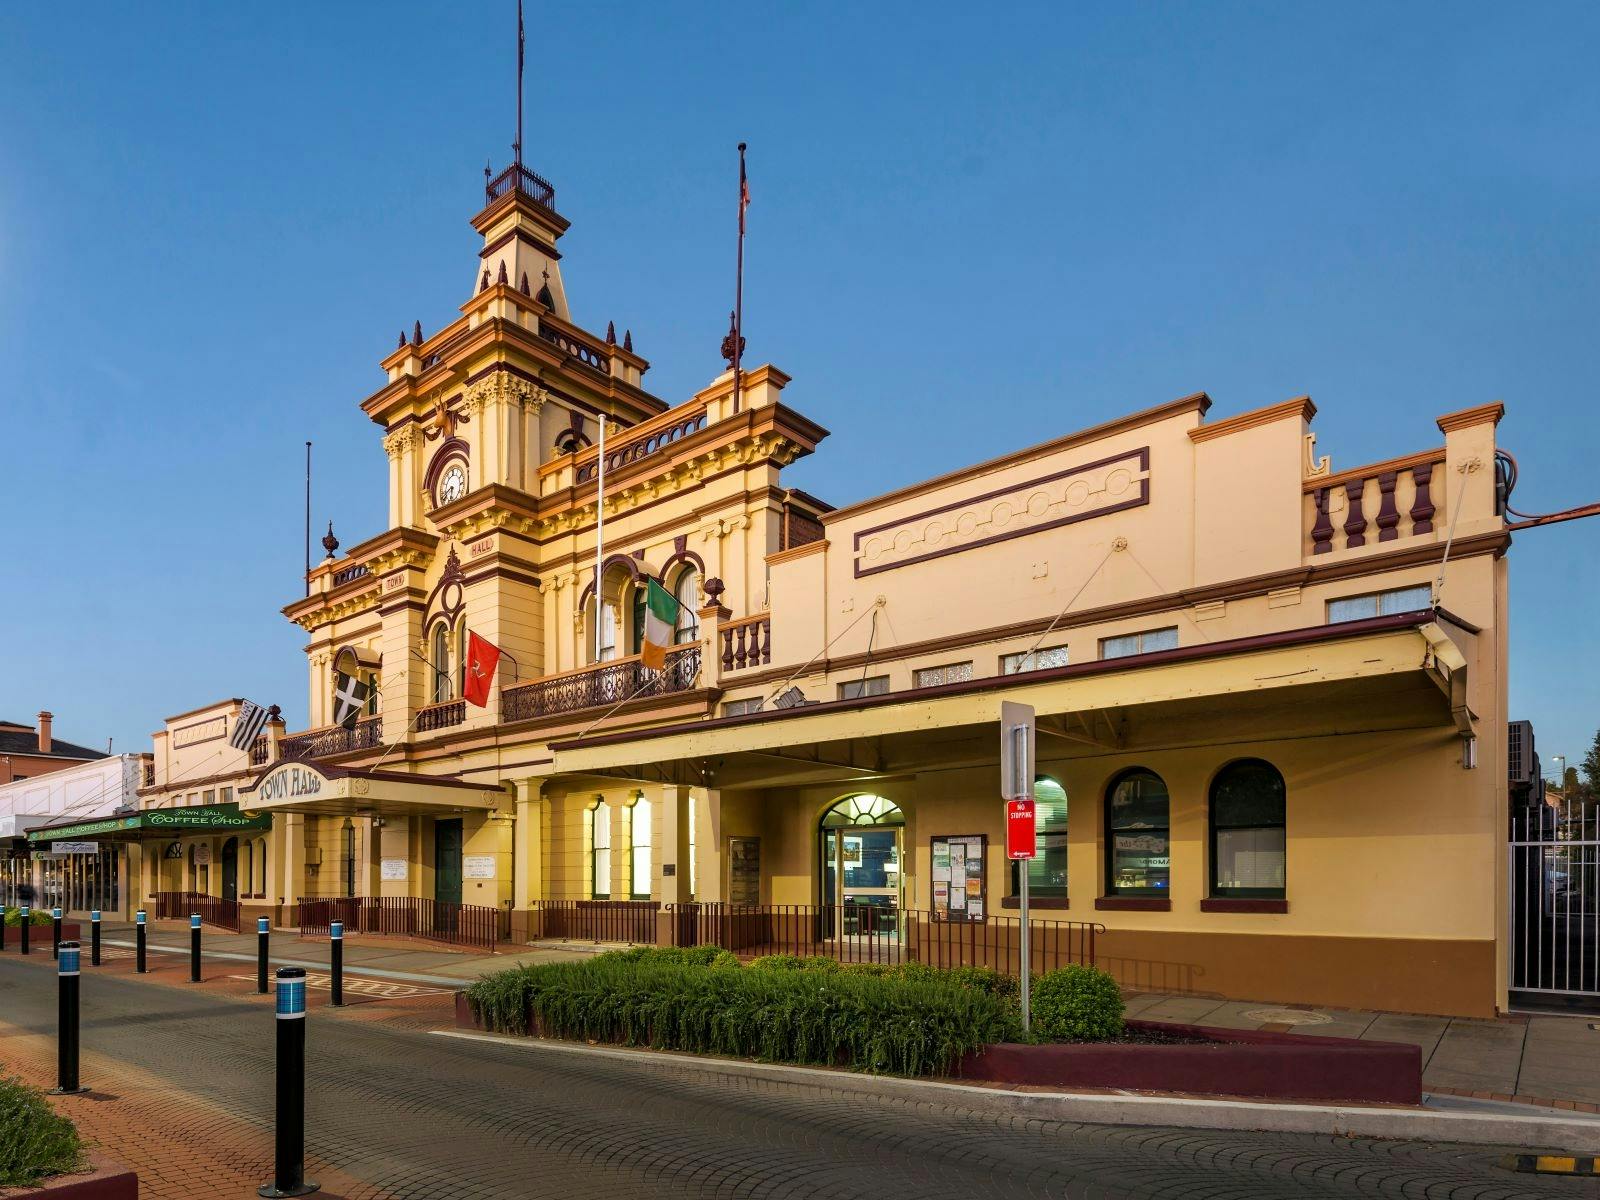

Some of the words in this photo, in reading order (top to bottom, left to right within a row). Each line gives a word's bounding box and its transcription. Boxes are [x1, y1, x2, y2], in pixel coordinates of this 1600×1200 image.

[471, 540, 492, 556] HALL
[260, 769, 288, 800] TOWN
[291, 767, 321, 796] HALL
[1017, 803, 1025, 811] NO
[200, 809, 222, 817] HALL
[1010, 811, 1032, 819] STOPPING
[148, 812, 209, 824] COFFEE
[211, 815, 250, 826] SHOP
